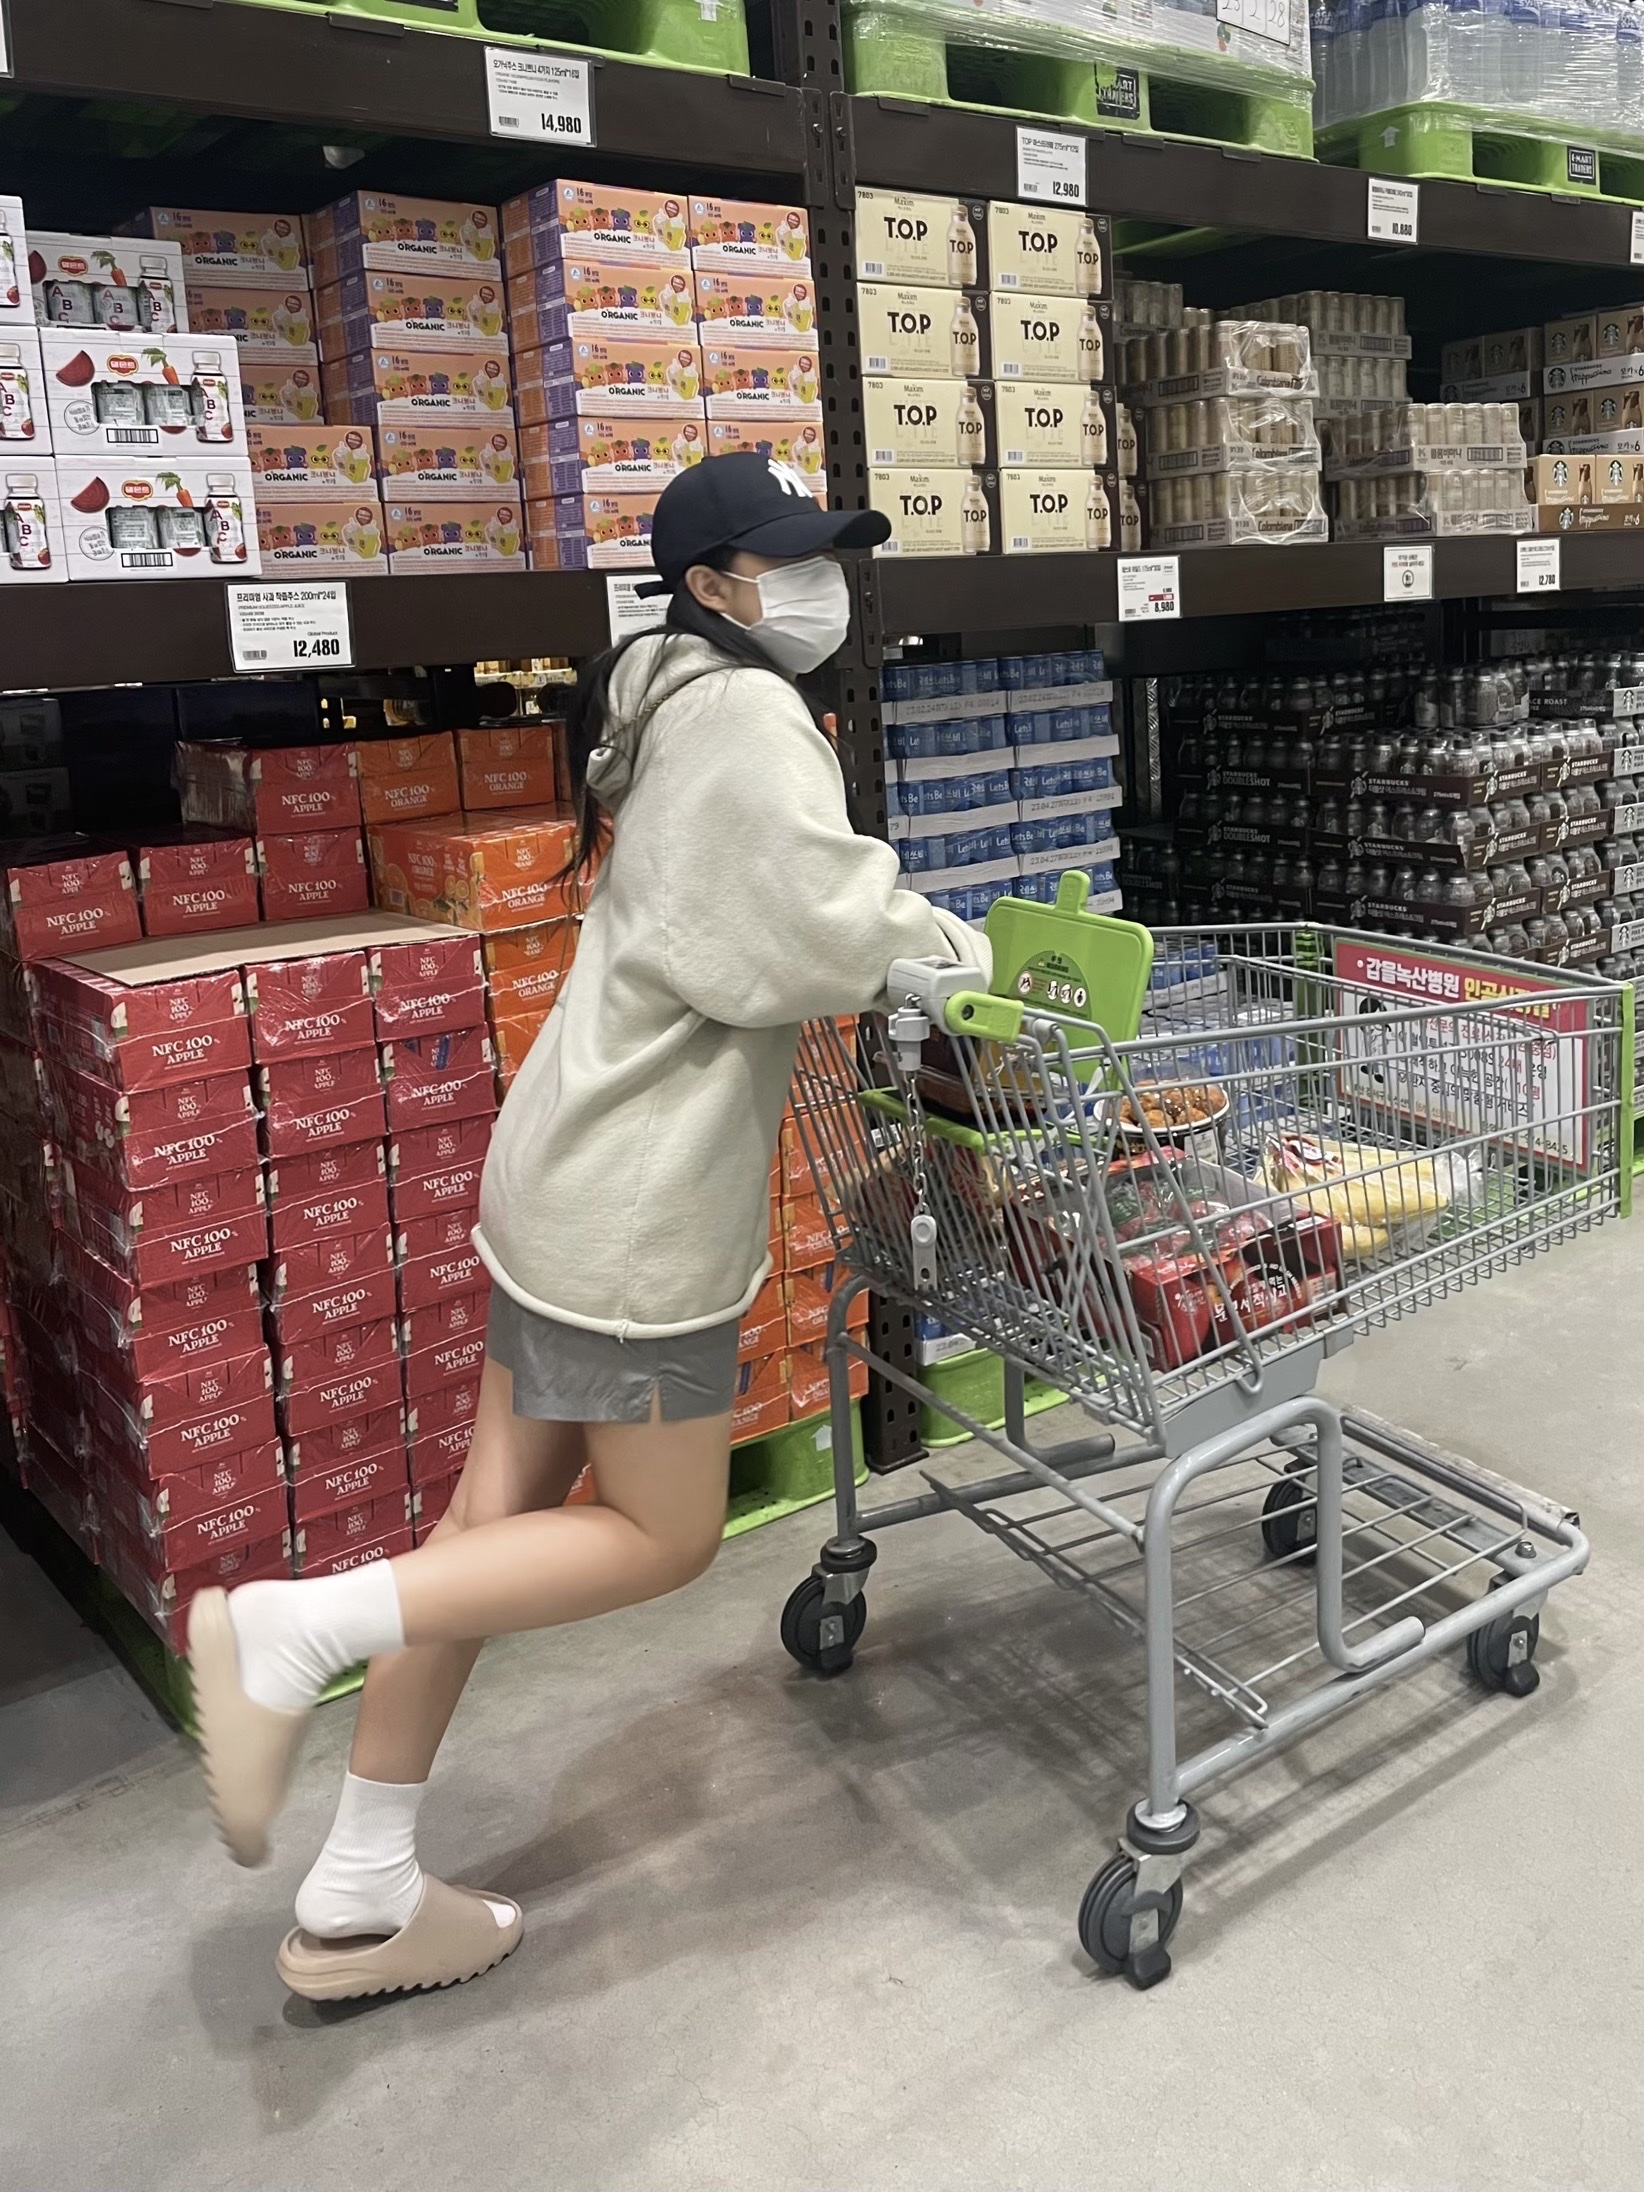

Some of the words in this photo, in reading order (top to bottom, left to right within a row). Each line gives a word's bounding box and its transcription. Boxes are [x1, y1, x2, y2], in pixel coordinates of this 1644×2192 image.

[541, 113, 582, 134] 14,980
[858, 191, 873, 200] 7803
[1053, 181, 1079, 197] 12,980
[884, 217, 928, 241] T.O.P
[950, 240, 974, 254] T.O.P
[1019, 231, 1057, 253] T.O.P
[1077, 252, 1099, 265] T.O.P
[862, 288, 877, 296] 7803
[887, 312, 931, 334] T.O.P
[1021, 320, 1059, 341] T.O.P
[953, 332, 976, 345] T.O.P
[1079, 339, 1100, 351] T.O.P
[894, 404, 937, 426] T.O.P
[1025, 408, 1063, 428] T.O.P
[959, 421, 982, 435] T.O.P
[1082, 423, 1104, 436] T.O.P
[875, 473, 890, 481] 7803
[900, 495, 942, 515] T.O.P
[1030, 494, 1068, 514] T.O.P
[964, 510, 987, 523] T.O.P
[1087, 508, 1108, 520] T.O.P
[262, 592, 274, 601] 사과
[1155, 601, 1174, 612] 8,980
[293, 639, 339, 658] 12,480
[1368, 779, 1408, 787] STARBUCKS
[282, 793, 306, 806] NFC
[307, 791, 331, 802] 100
[292, 802, 323, 813] APPLE
[172, 893, 201, 906] NFC
[202, 889, 225, 902] 100
[184, 901, 218, 914] APPLE
[46, 914, 77, 928] NFC
[77, 907, 104, 922] 100
[60, 920, 97, 935] APPLE
[1366, 957, 1459, 998] 갑을녹산병원
[316, 1015, 341, 1027] 100
[297, 1027, 332, 1040] APPLE
[152, 1043, 184, 1057] NFC
[185, 1035, 213, 1049] 100
[167, 1049, 204, 1065] APPLE
[423, 1177, 450, 1191] NFC
[451, 1171, 473, 1184] 100
[434, 1183, 466, 1197] APPLE
[304, 1203, 333, 1220] NFC
[333, 1197, 357, 1211] 100
[316, 1211, 349, 1227] APPLE
[170, 1234, 202, 1253] NFC
[203, 1227, 231, 1243] 100
[185, 1242, 222, 1259] APPLE
[312, 1296, 341, 1314] NFC
[342, 1289, 366, 1304] 100
[324, 1303, 358, 1320] APPLE
[168, 1327, 199, 1347] NFC
[201, 1319, 227, 1336] 100
[182, 1333, 219, 1353] APPLE
[434, 1348, 461, 1366] NFC
[462, 1341, 484, 1355] 100
[445, 1354, 477, 1370] APPLE
[320, 1384, 349, 1402] NFC
[349, 1377, 372, 1391] 100
[331, 1391, 365, 1408] APPLE
[180, 1424, 212, 1442] NFC
[213, 1414, 240, 1431] 100
[194, 1429, 231, 1448] APPLE
[325, 1472, 354, 1490] NFC
[354, 1463, 378, 1478] 100
[336, 1477, 369, 1495] APPLE
[197, 1515, 229, 1535] NFC
[230, 1505, 255, 1522] 100
[210, 1520, 246, 1539] APPLE
